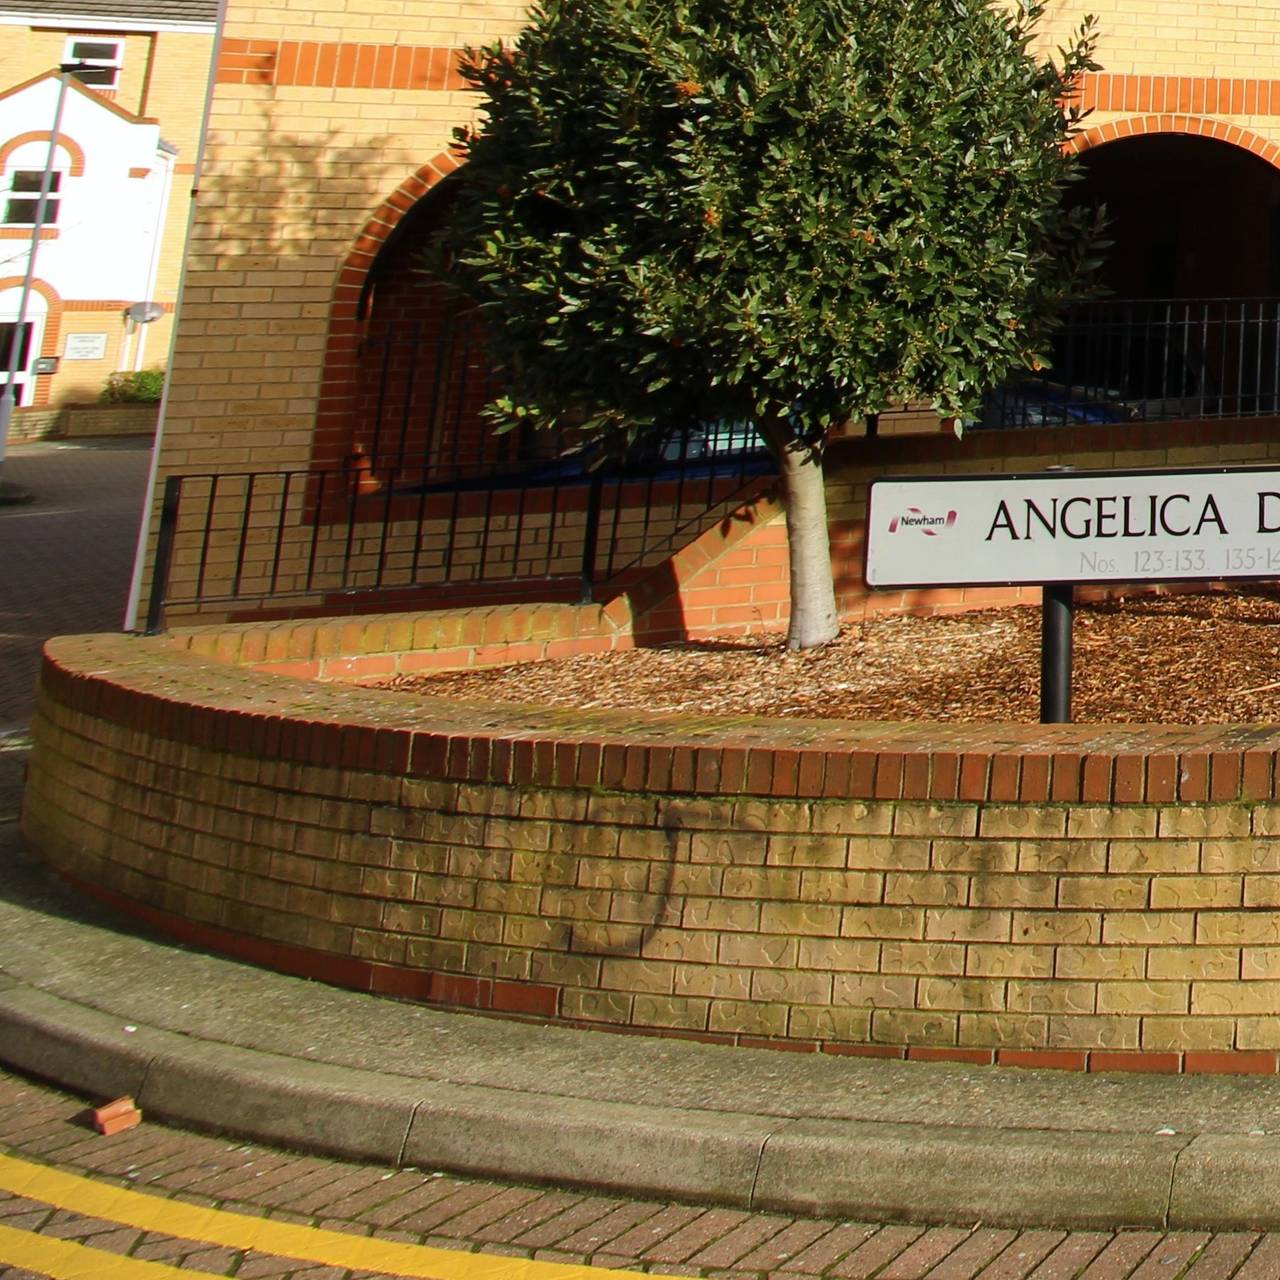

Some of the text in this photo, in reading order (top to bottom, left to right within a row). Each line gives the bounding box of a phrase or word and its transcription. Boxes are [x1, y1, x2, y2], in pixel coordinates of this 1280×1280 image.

[900, 515, 945, 527] Newham
[984, 492, 1230, 541] ANGELICA
[1079, 550, 1120, 574] Nos.
